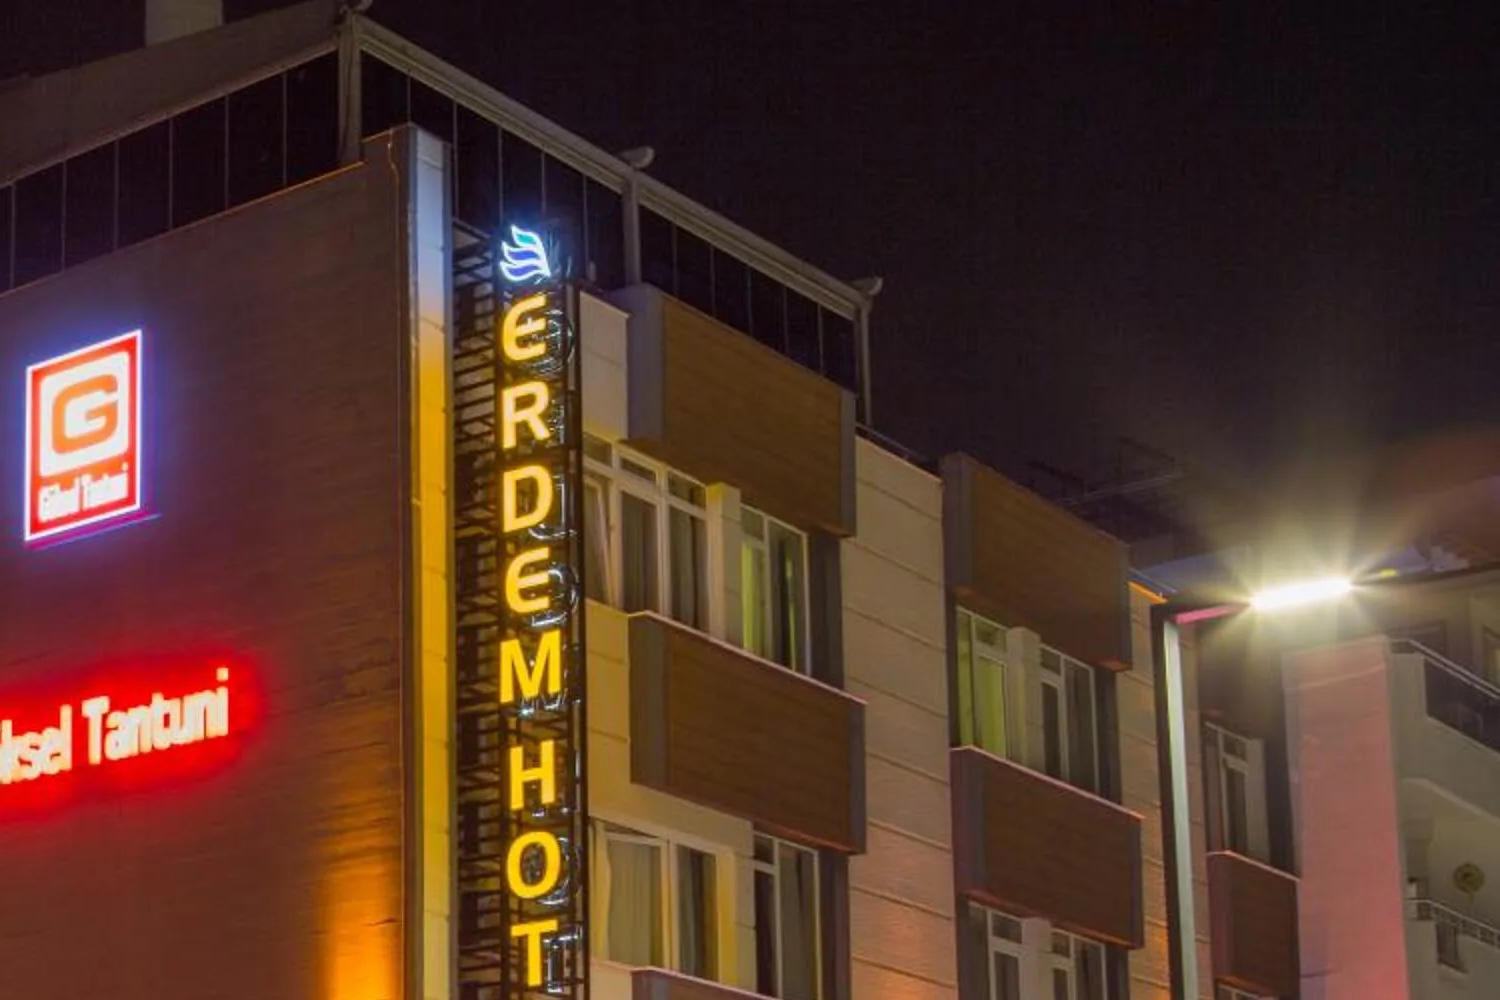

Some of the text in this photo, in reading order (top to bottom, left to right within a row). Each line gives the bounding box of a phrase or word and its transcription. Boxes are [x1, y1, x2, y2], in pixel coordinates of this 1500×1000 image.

[51, 374, 118, 455] G
[501, 295, 563, 702] ERDEM
[82, 667, 229, 765] Tantuni
